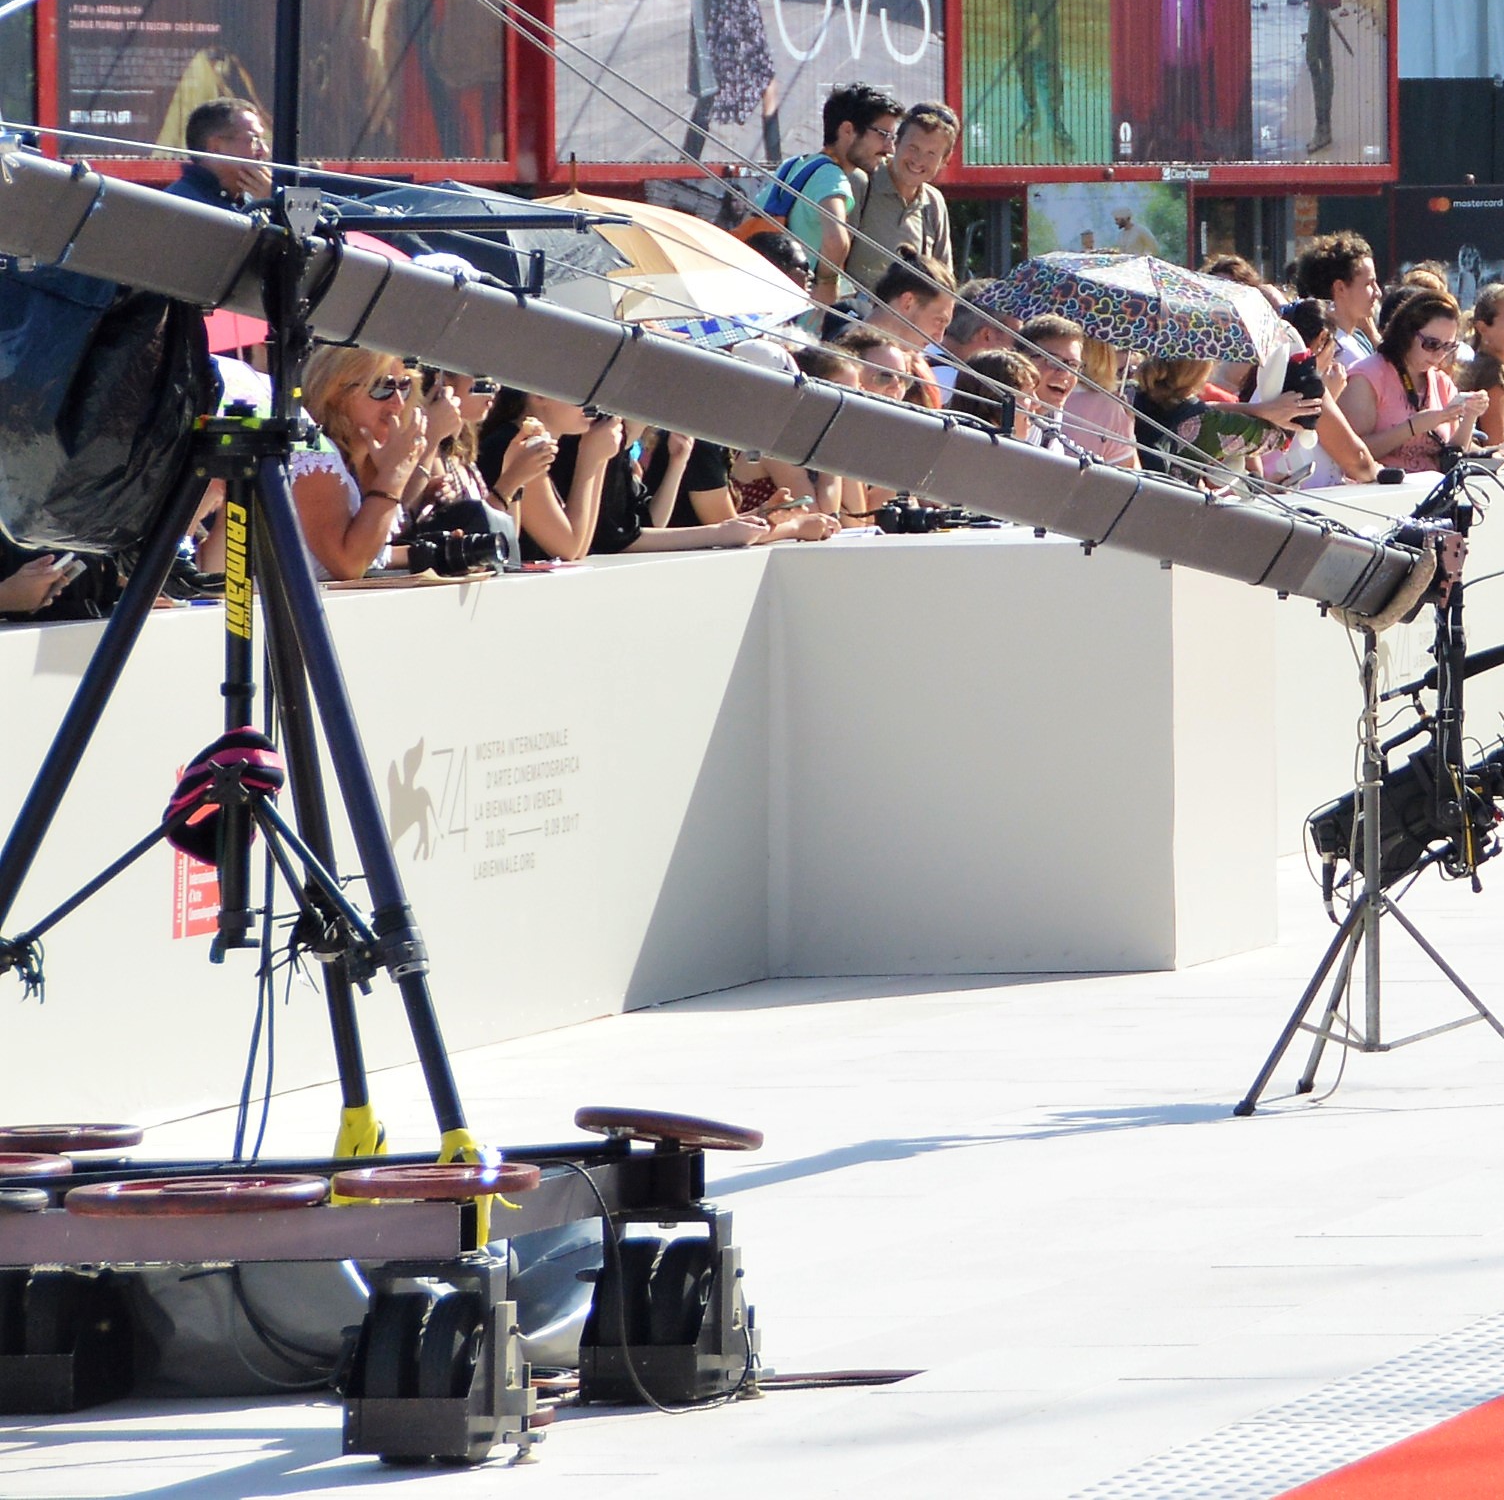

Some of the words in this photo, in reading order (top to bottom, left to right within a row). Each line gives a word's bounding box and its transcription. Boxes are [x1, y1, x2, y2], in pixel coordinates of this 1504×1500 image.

[1453, 199, 1504, 208] mastercard
[475, 740, 506, 761] MOSTRA
[507, 728, 569, 754] INTERNAZIONALE
[513, 756, 580, 785] CINEMATOGRAFICA
[431, 746, 469, 860] 74
[474, 802, 484, 821] LA
[485, 795, 522, 819] BIENNALE
[523, 794, 531, 812] DI
[532, 788, 563, 811] VENEZIA
[473, 852, 536, 880] LABIENNALE.ORG
